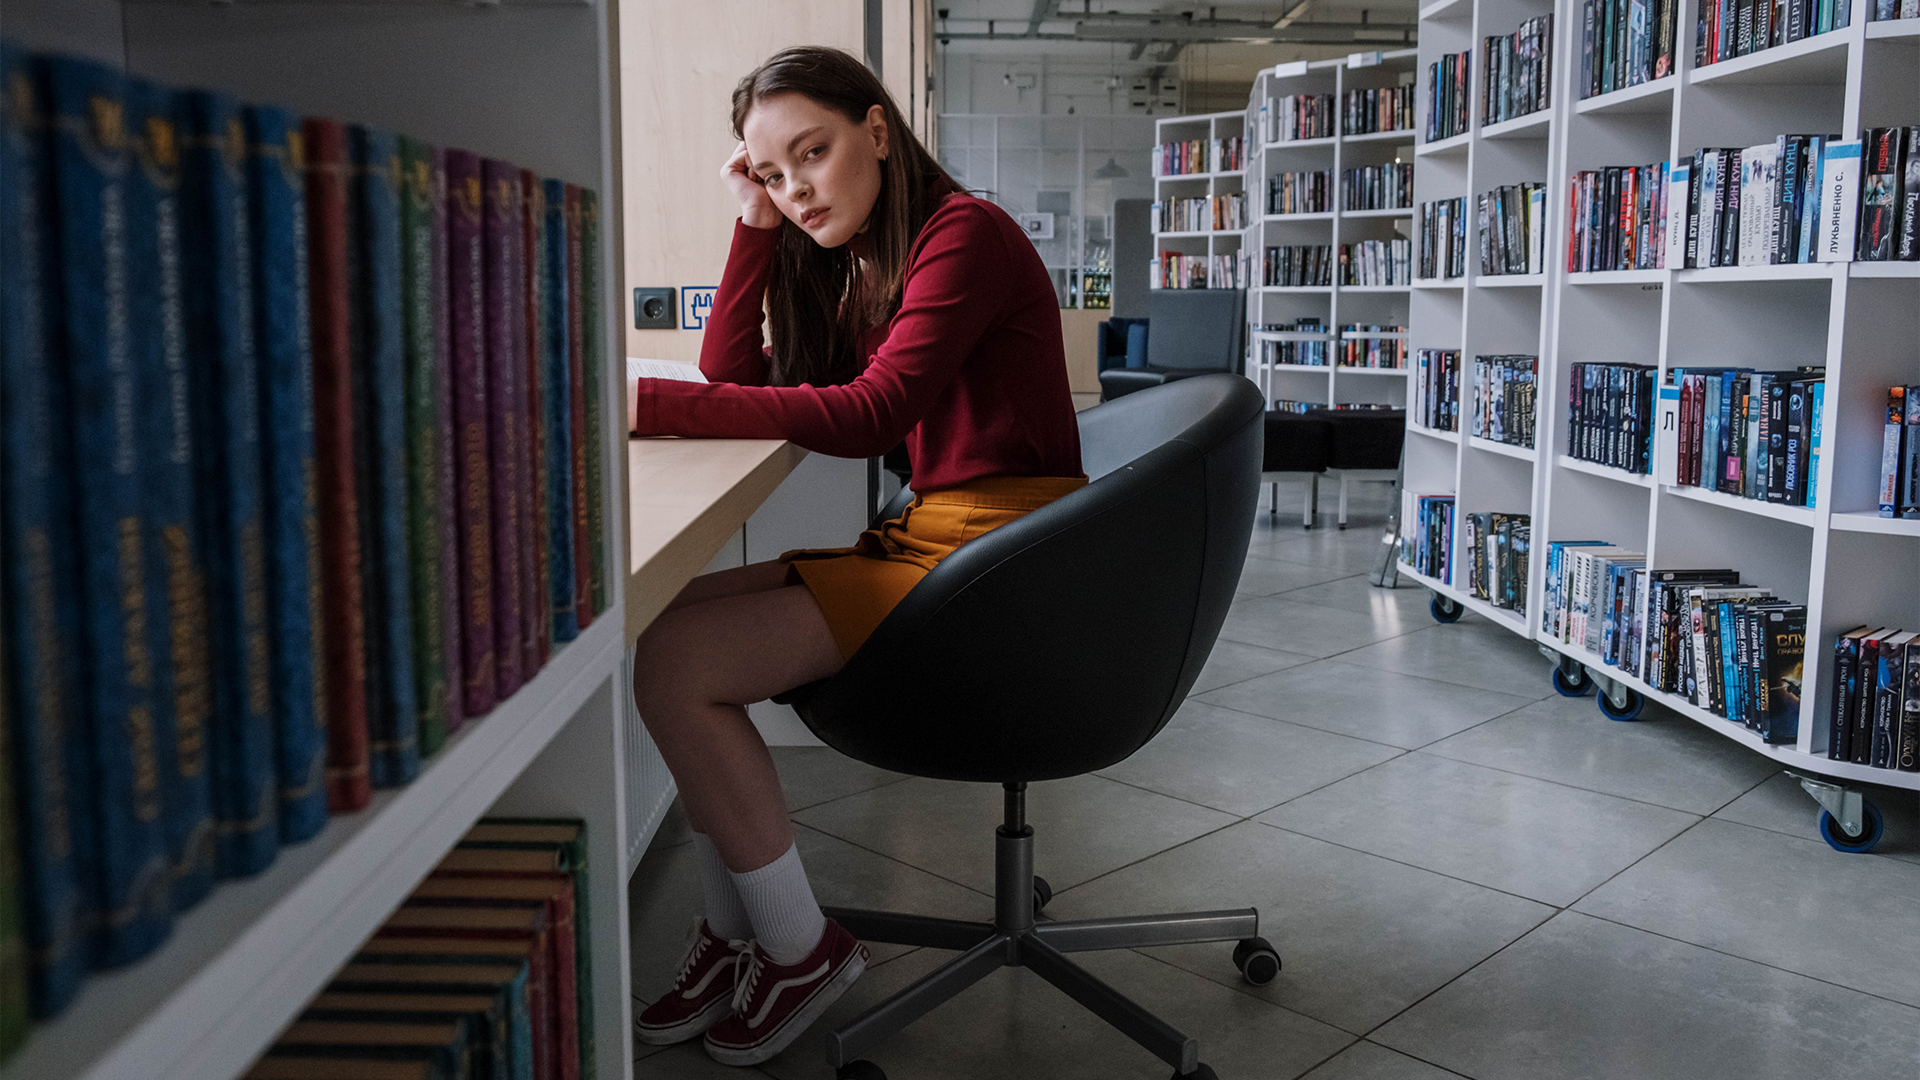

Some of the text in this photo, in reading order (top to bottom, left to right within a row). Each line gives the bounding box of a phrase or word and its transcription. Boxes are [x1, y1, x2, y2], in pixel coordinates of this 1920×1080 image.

[1760, 2, 1768, 45] КРОНИН
[1783, 142, 1797, 204] ДИН КУНЦ
[1878, 134, 1889, 172] ГЛУБИНА
[1692, 174, 1700, 204] ГОРОД
[1714, 155, 1727, 211] ДИН КУНЦ
[1729, 152, 1742, 209] ДИН КУНЦ
[1688, 214, 1698, 258] ДИН КУНЦ
[1770, 206, 1782, 254] ДИН КУНЦ
[1830, 172, 1844, 254] ЛУКЬЯНЕНКО С.
[1663, 411, 1674, 431] Л
[1730, 407, 1740, 456] ЛАВКРАФТ
[1785, 438, 1798, 490] ЛЮБОВНИК РОЗ
[1888, 427, 1898, 465] КОНКУРЕНТЫ
[1590, 560, 1600, 618] КОРЧЕВСКИЙ
[1840, 666, 1848, 683] ТРОН
[1838, 684, 1846, 726] СТЕКЛЯННЫЙ
